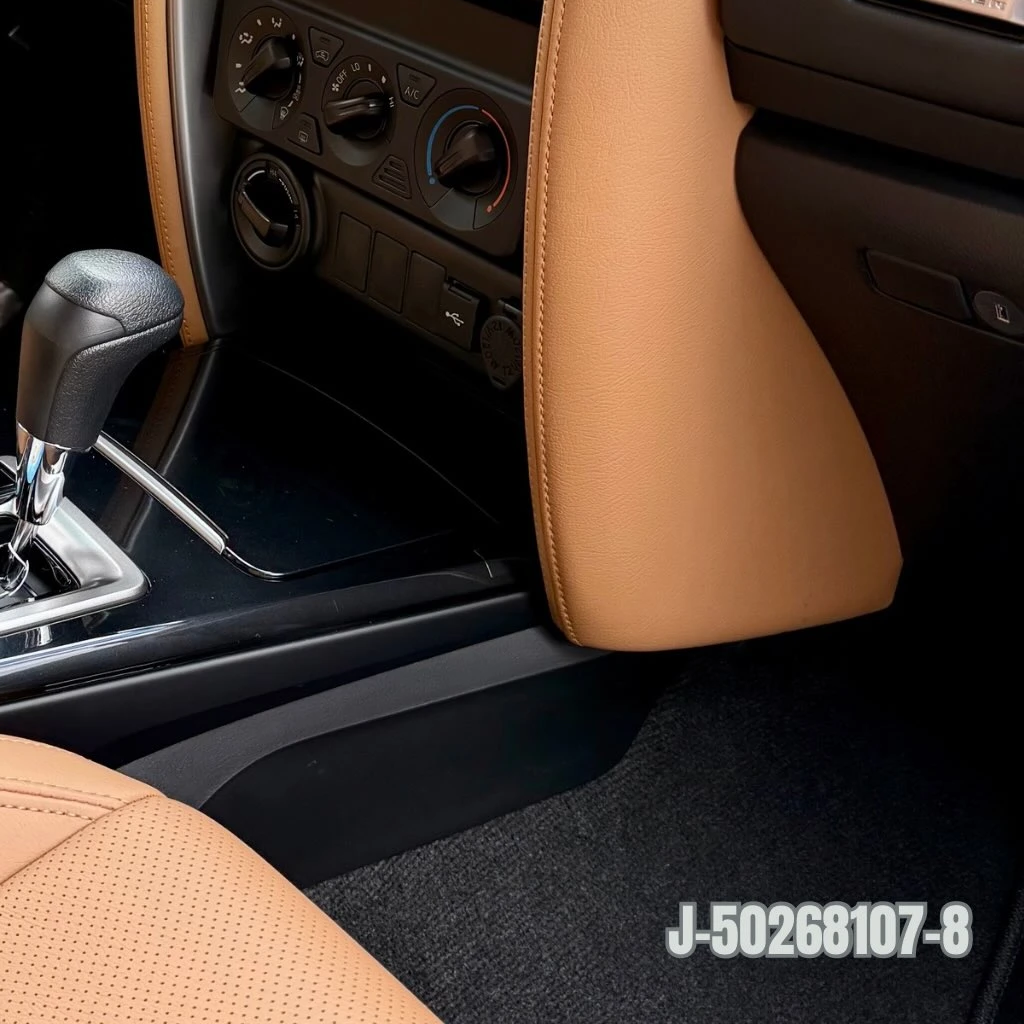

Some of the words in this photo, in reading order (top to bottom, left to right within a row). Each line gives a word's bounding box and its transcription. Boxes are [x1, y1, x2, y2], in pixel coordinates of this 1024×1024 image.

[350, 62, 361, 72] LO
[336, 69, 348, 84] OFF
[405, 86, 419, 100] A/C
